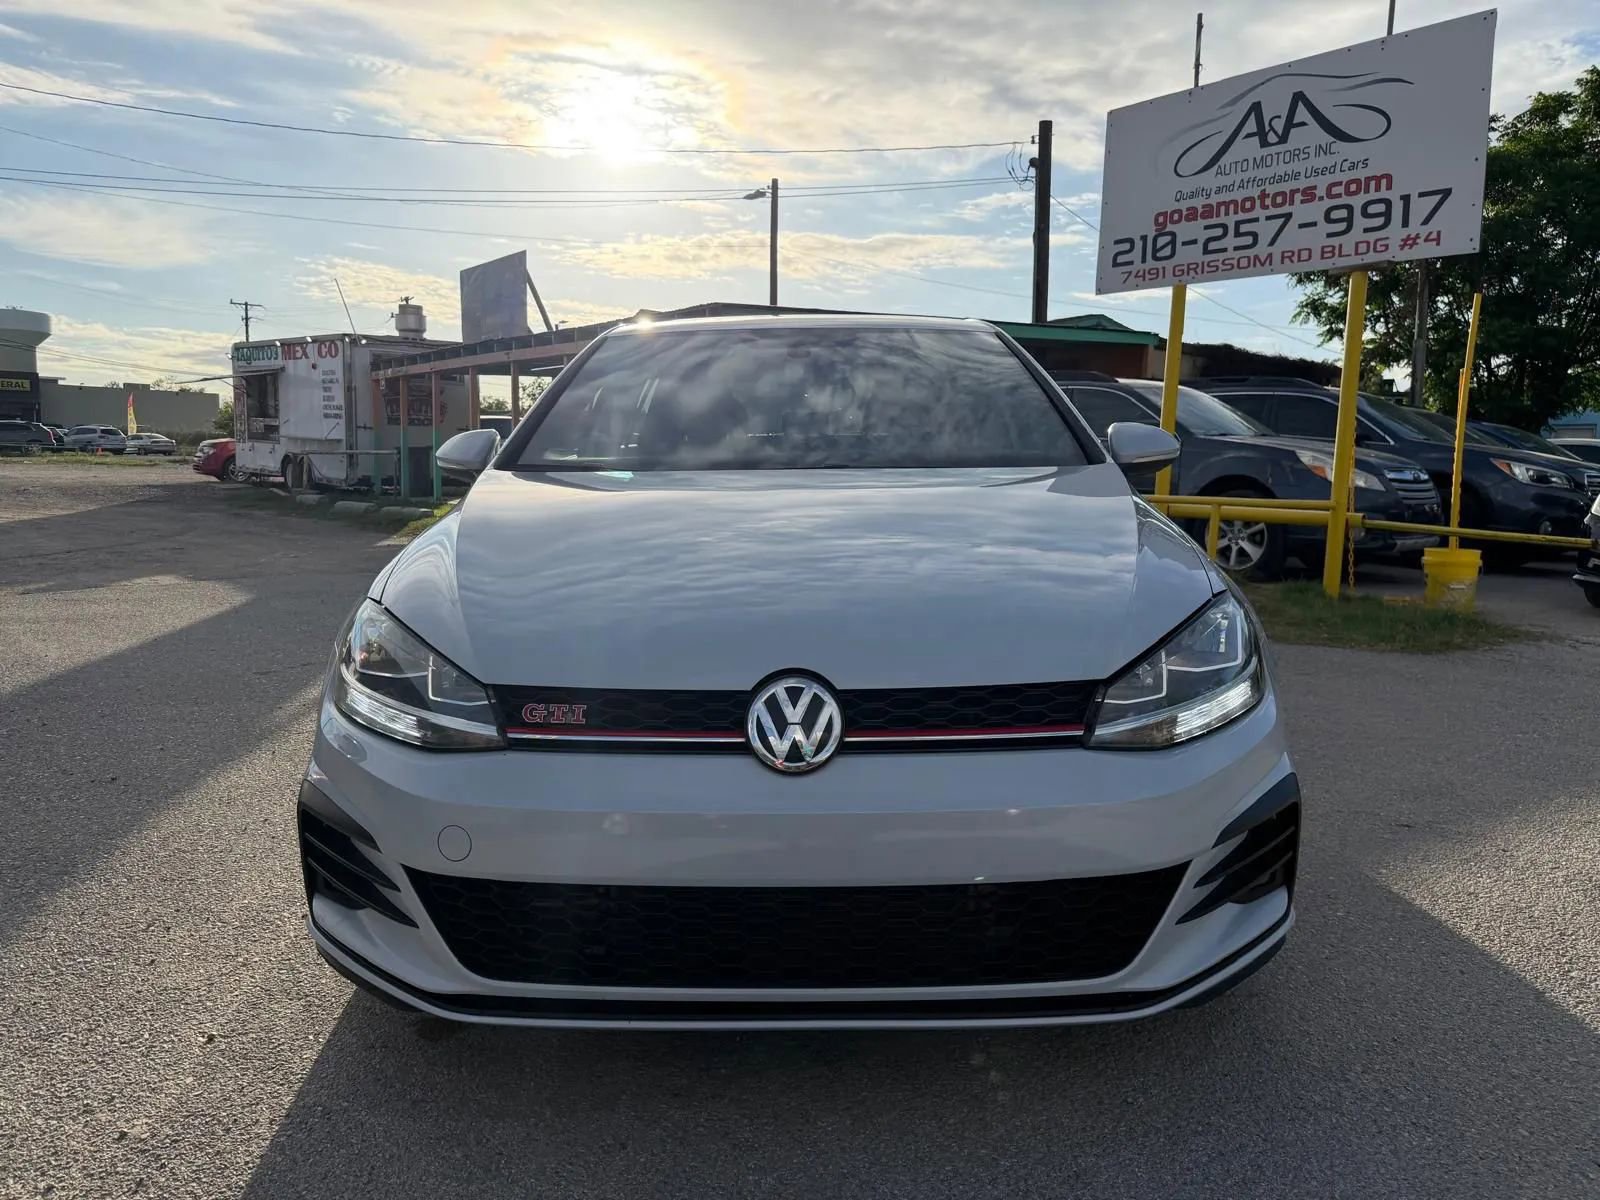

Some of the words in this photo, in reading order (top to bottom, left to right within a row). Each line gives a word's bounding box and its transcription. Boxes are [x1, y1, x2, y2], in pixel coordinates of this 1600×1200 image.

[1174, 186, 1212, 202] Quality
[1214, 181, 1236, 195] and
[1236, 170, 1301, 192] Affordable
[1304, 162, 1337, 179] Used
[1339, 157, 1370, 173] Cars
[1214, 159, 1249, 178] AUTO
[1252, 145, 1311, 170] MOTORS
[1314, 141, 1341, 158] INC.
[1111, 187, 1453, 269] 210-257-9917
[1153, 173, 1393, 234] goaamotors.com
[1120, 266, 1167, 285] 7491
[1172, 252, 1274, 279] GRISSOM
[1280, 247, 1313, 265] RD
[1319, 236, 1391, 261] BLDG
[1398, 230, 1442, 251] #4
[521, 703, 587, 725] GTI
